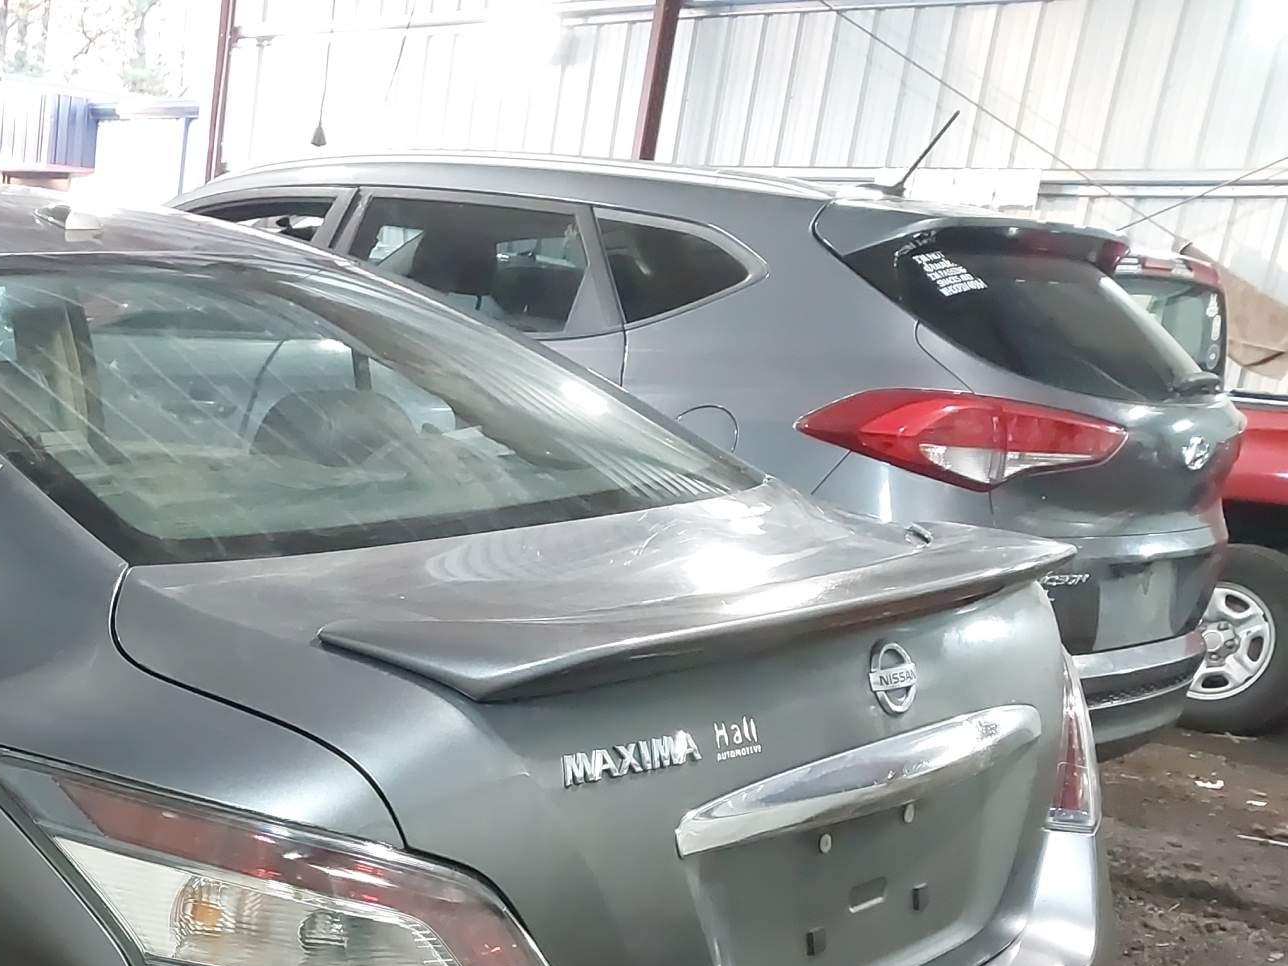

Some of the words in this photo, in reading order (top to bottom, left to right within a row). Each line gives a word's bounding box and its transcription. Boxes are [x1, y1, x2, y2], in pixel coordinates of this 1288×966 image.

[879, 670, 917, 686] NISSAN
[714, 716, 759, 749] Hall
[562, 730, 703, 788] MAXIMA
[717, 744, 762, 762] AUTOMOTIVE
